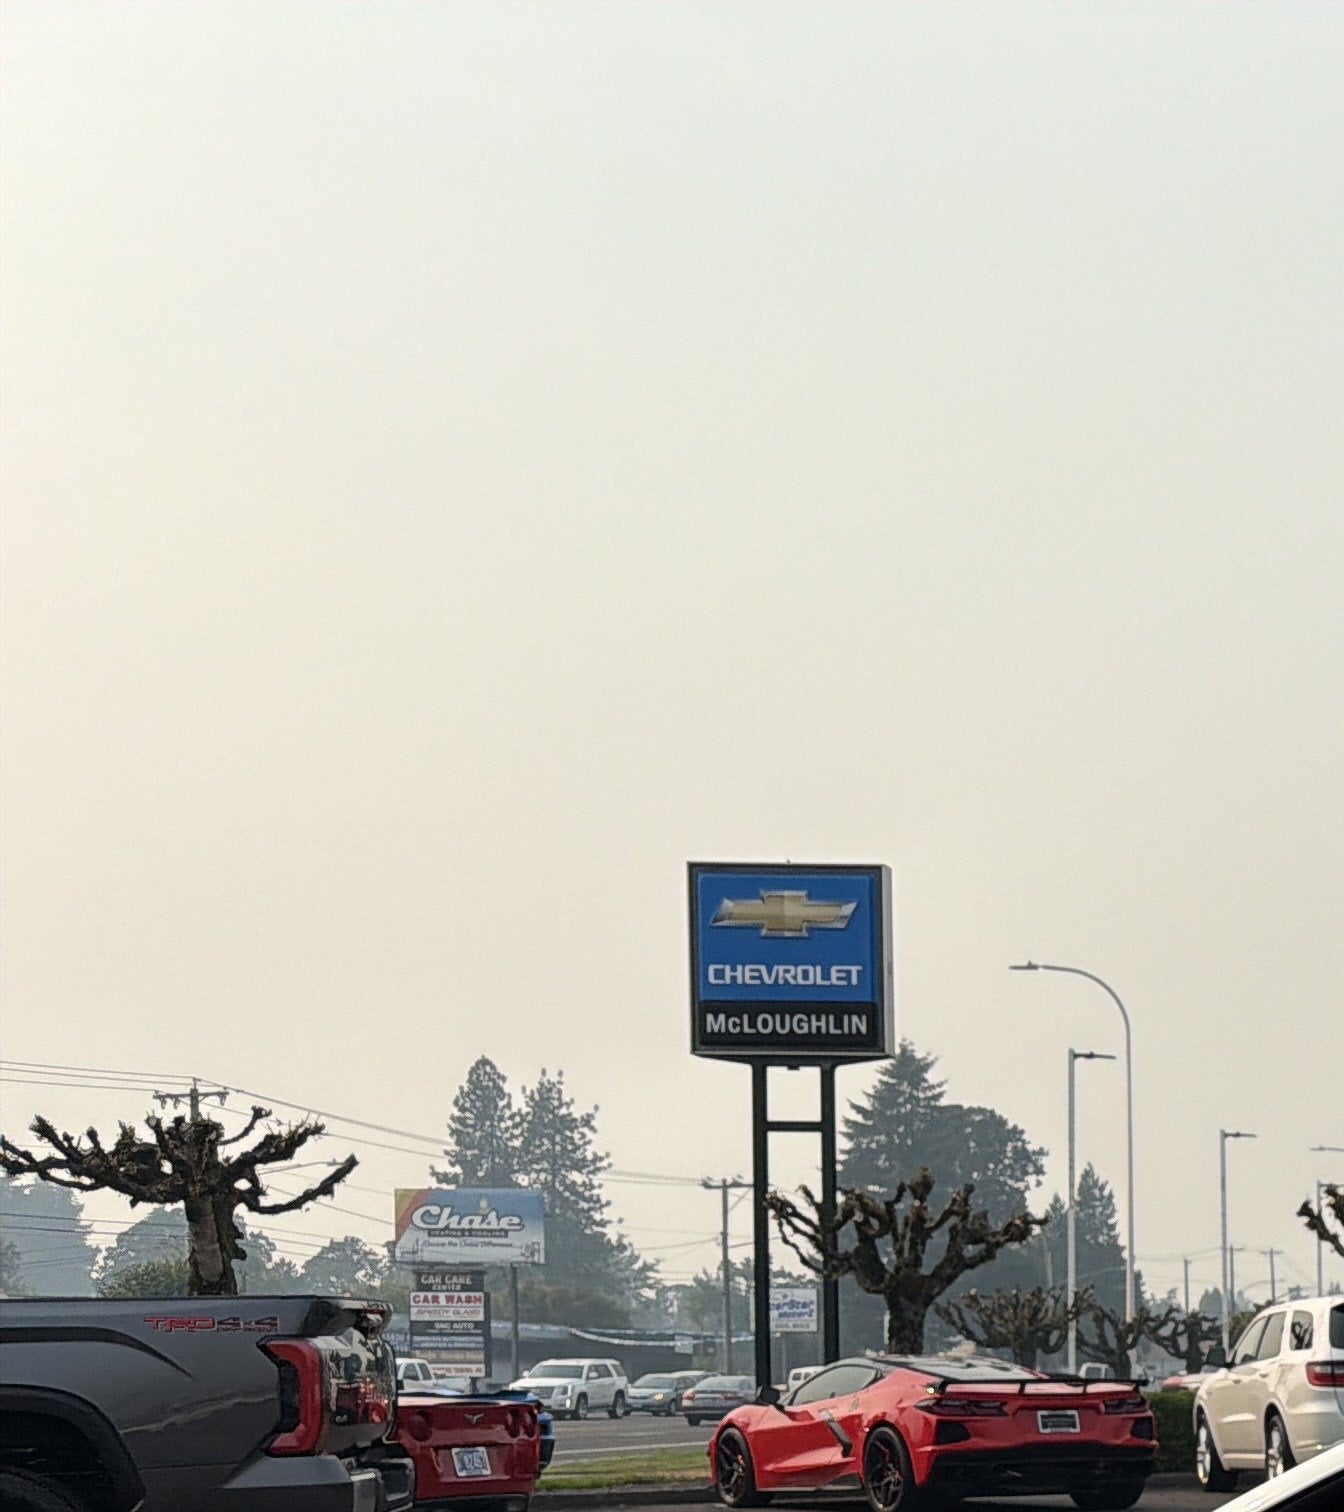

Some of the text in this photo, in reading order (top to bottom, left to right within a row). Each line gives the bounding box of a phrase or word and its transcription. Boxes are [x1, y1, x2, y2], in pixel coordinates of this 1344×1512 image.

[708, 964, 863, 986] CHEVROLET
[706, 1013, 868, 1035] McLOUGHLIN
[411, 1204, 524, 1231] Chase
[420, 1274, 472, 1285] CAR CARE
[412, 1294, 483, 1305] CAR WASH
[143, 1316, 216, 1332] TRD
